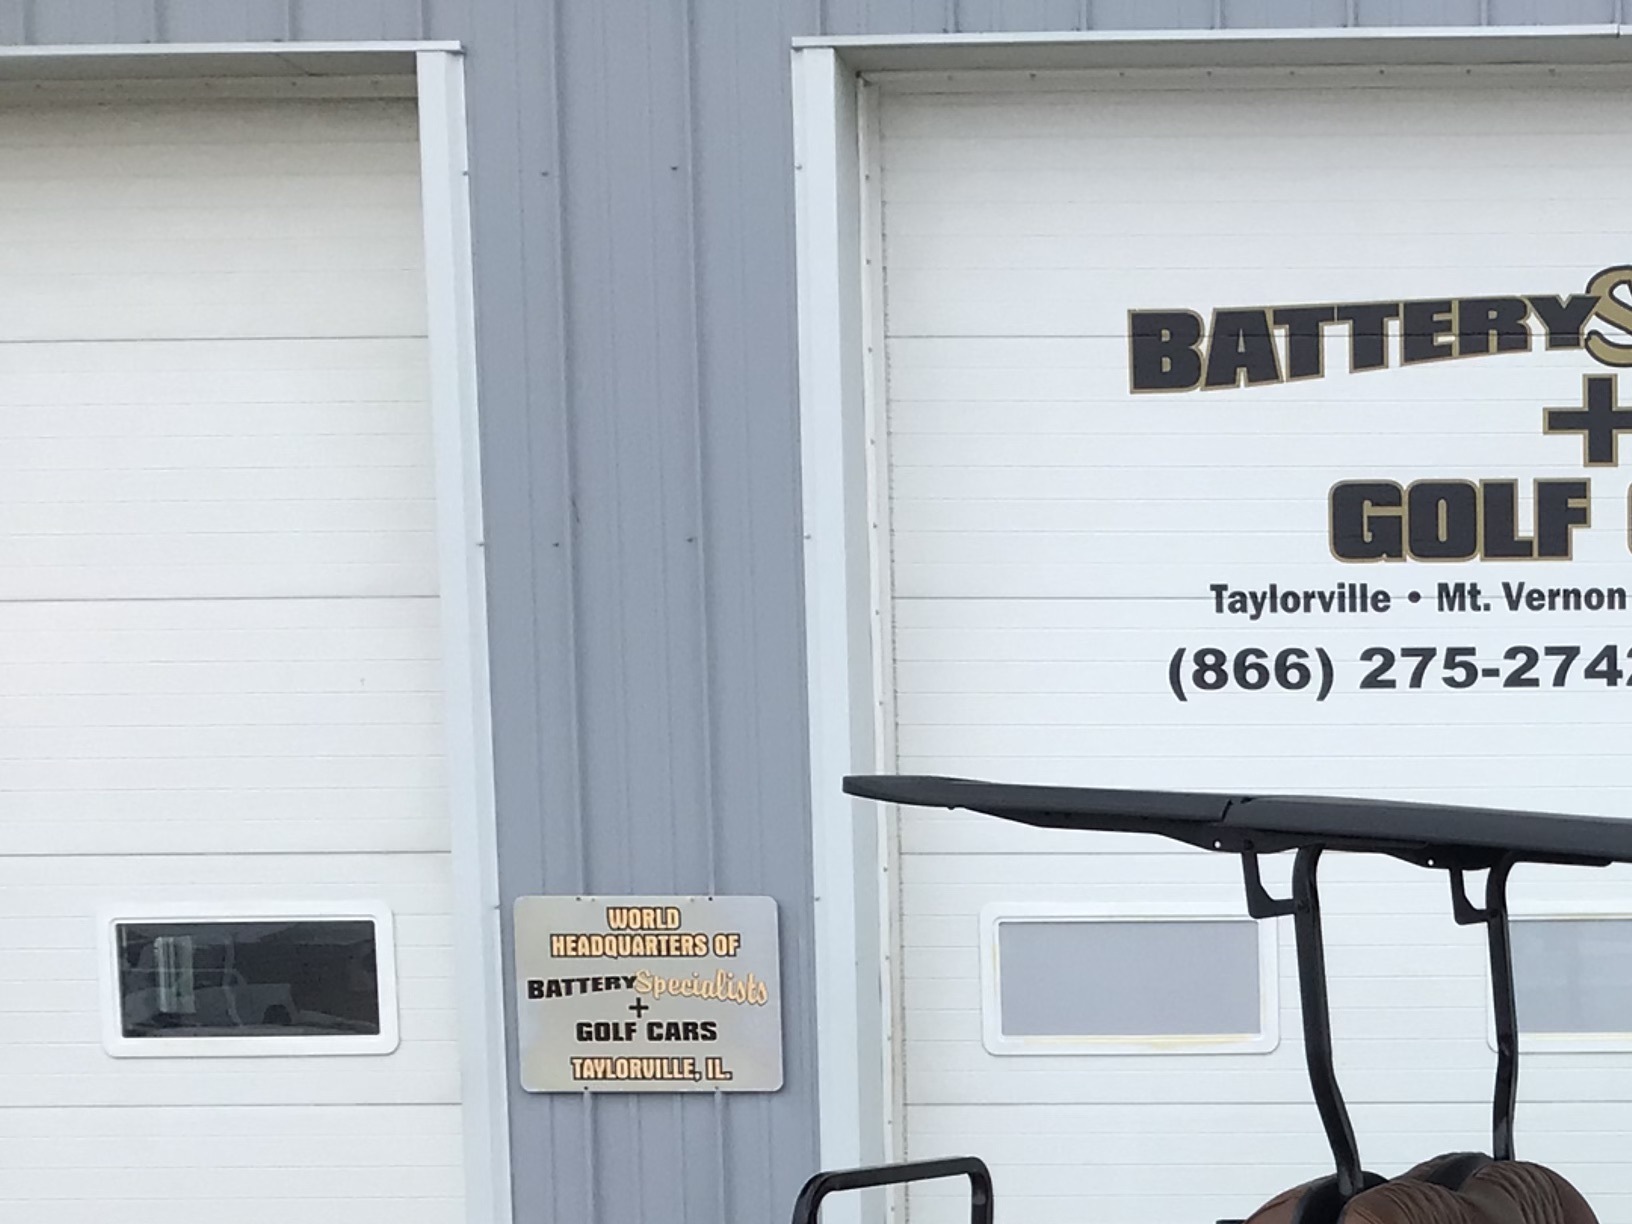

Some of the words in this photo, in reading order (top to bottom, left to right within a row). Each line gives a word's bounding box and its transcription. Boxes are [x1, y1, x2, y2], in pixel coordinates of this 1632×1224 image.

[1128, 294, 1604, 394] BATTERY
[1329, 476, 1592, 564] GOLF
[1210, 582, 1393, 618] Taylorville
[1436, 582, 1493, 612] Mt.
[1501, 581, 1628, 612] Vernon
[1166, 645, 1337, 702] (866)
[607, 906, 681, 931] WORLD
[550, 934, 708, 959] HEADQUARTERS
[713, 934, 741, 957] OF
[527, 975, 638, 1000] BATTERY
[634, 969, 769, 1006] Specialists
[576, 1022, 637, 1041] GOLF
[647, 1021, 718, 1041] CARS
[570, 1057, 702, 1082] TAYLORVILLE,
[705, 1057, 733, 1081] IL.
